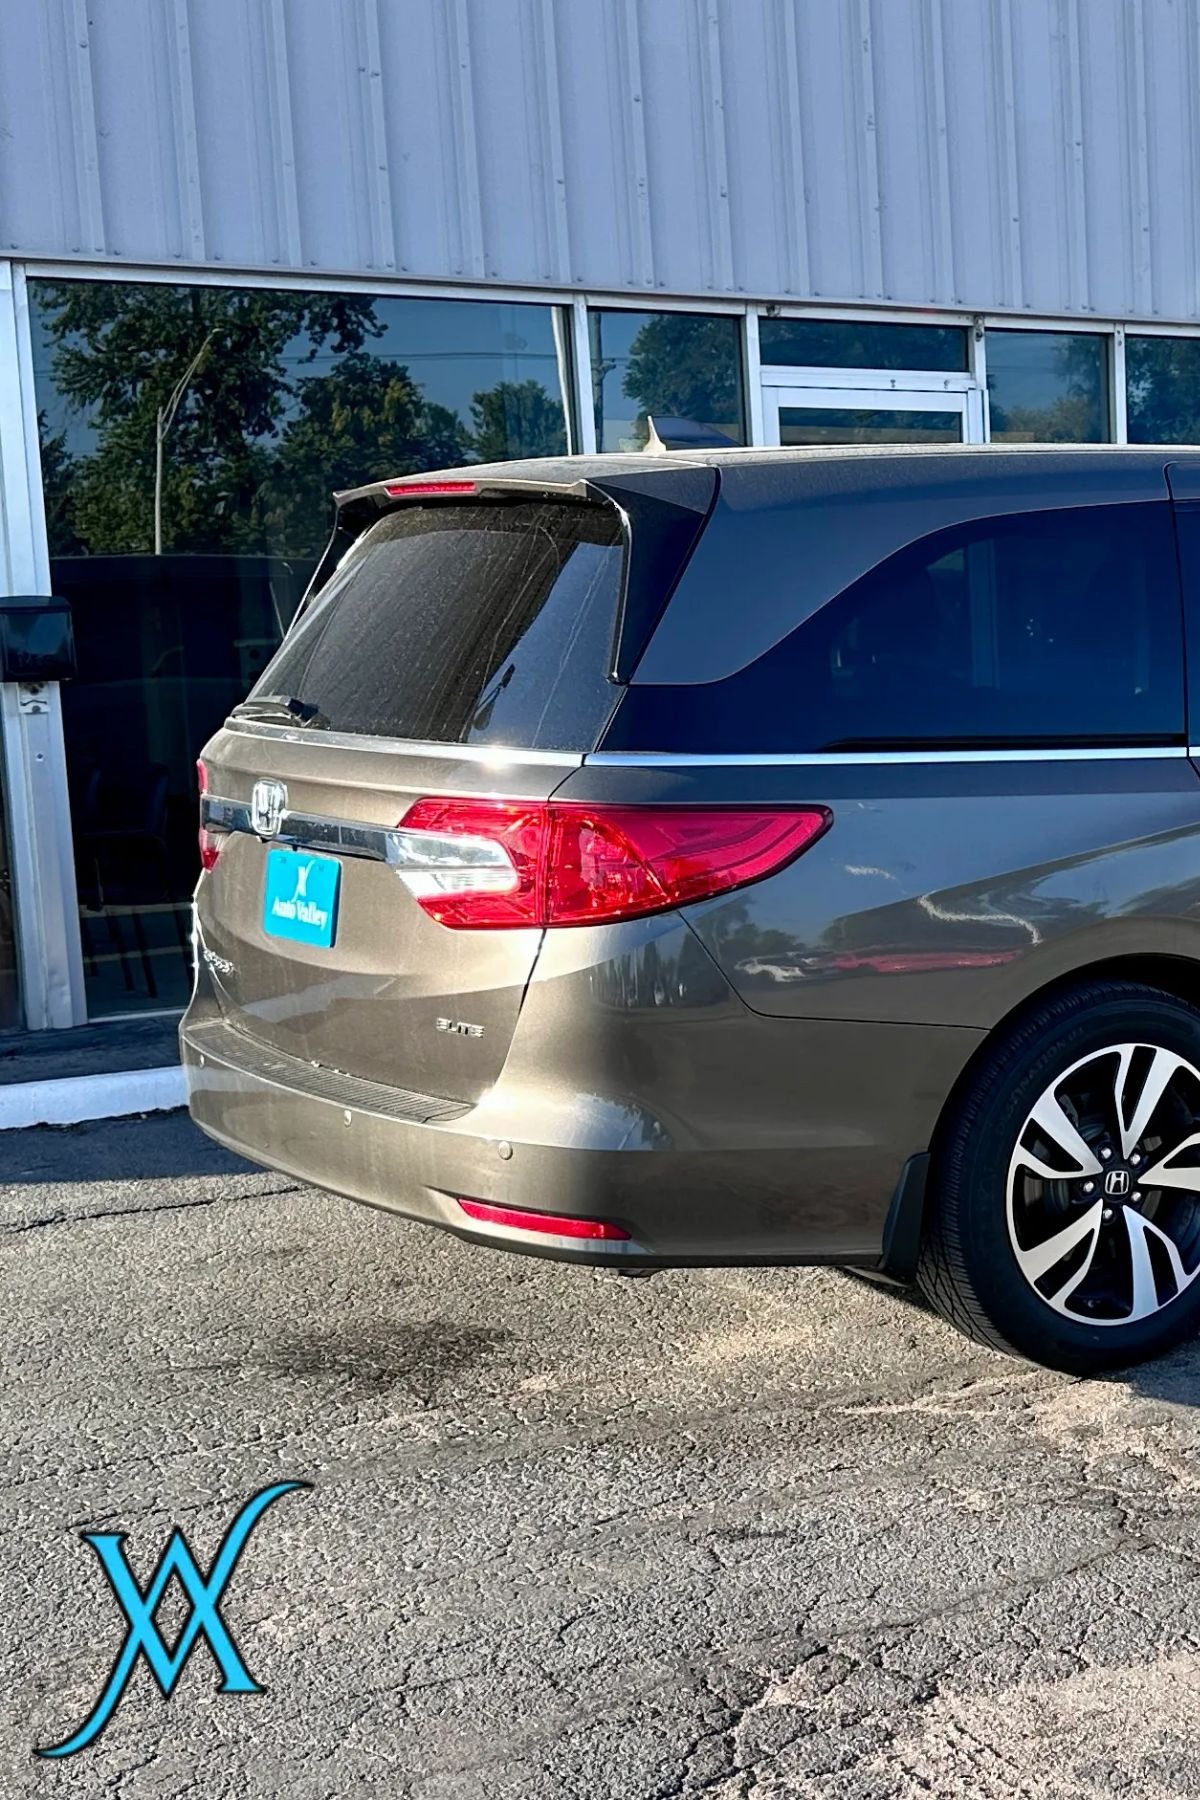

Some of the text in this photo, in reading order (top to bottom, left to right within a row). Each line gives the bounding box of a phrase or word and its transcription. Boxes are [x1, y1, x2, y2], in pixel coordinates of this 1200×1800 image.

[272, 896, 329, 931] Auto Valley
[435, 1017, 486, 1039] ELITE
